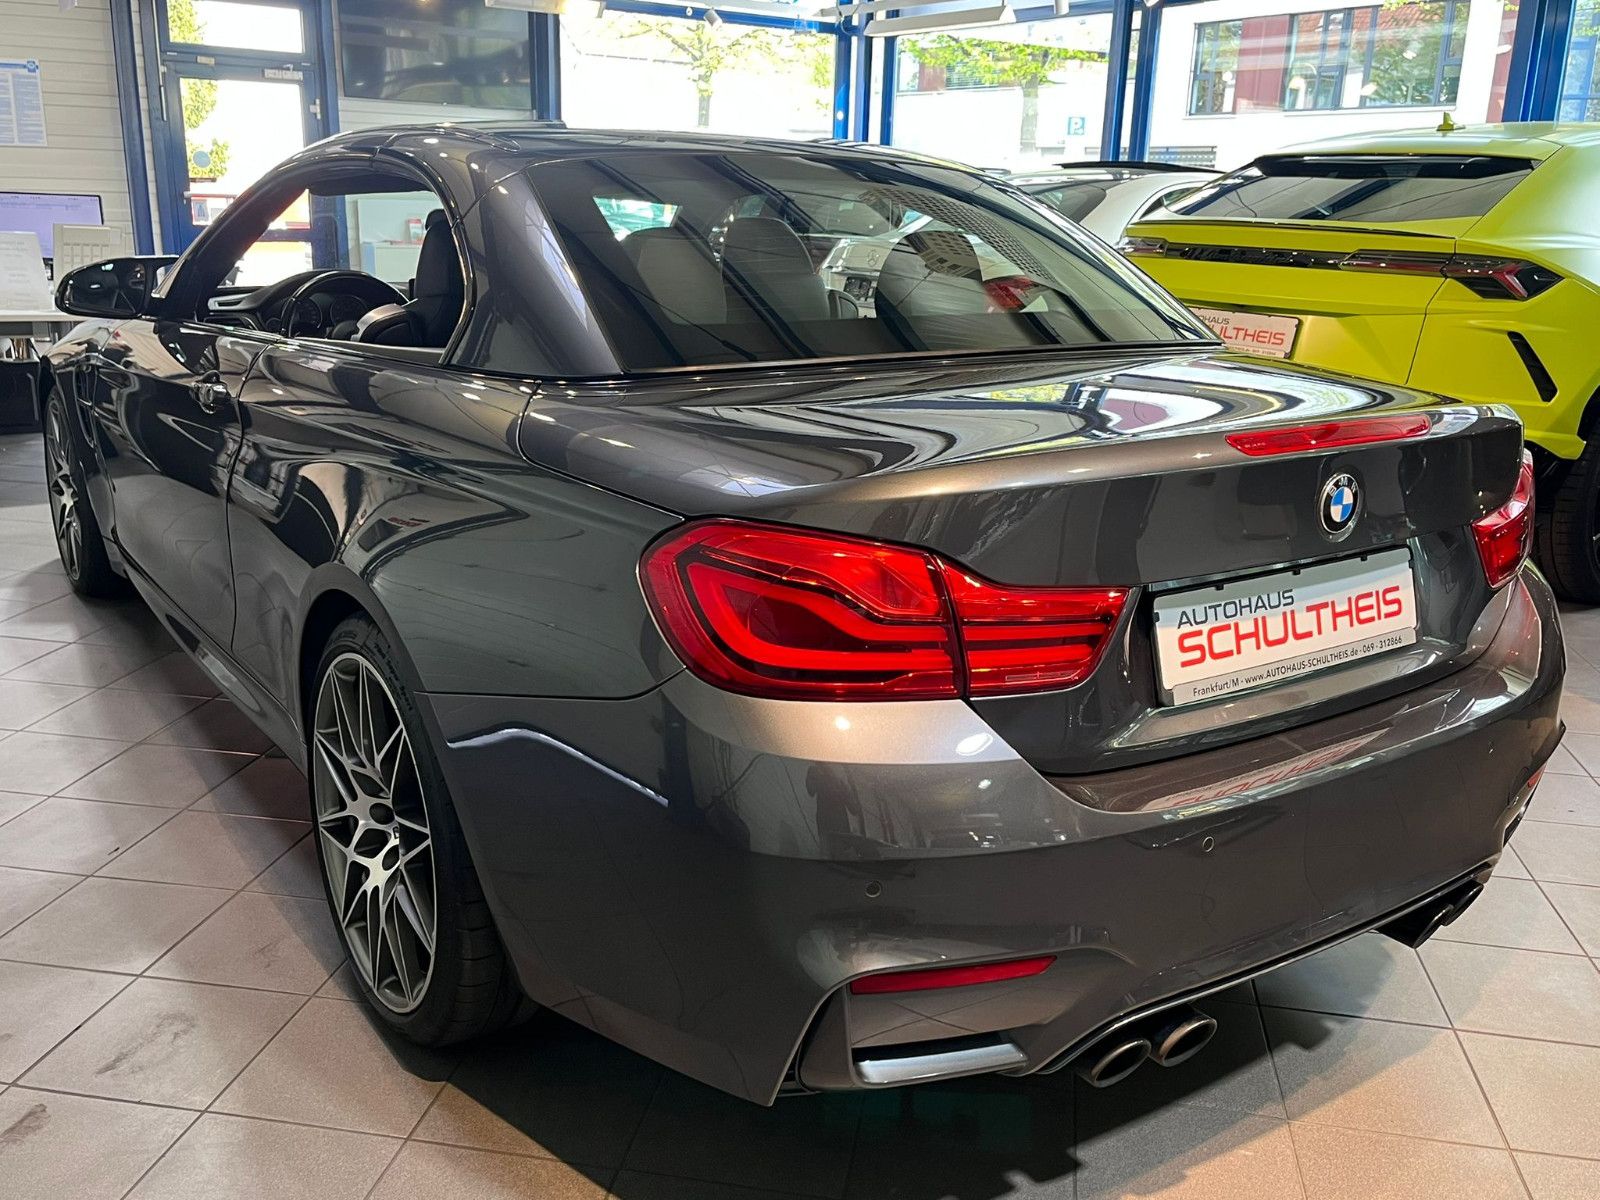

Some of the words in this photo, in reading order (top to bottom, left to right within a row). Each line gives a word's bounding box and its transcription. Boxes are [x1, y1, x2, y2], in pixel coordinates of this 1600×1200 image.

[1070, 117, 1083, 135] P
[1199, 315, 1230, 325] OHAUS
[1211, 324, 1286, 346] ULTHEIS
[1328, 476, 1358, 497] BMW
[1177, 588, 1295, 629] AUTOHAUS
[1178, 585, 1403, 668] SCHULTHEIS
[1193, 677, 1240, 697] Frankfurt/M
[1244, 647, 1359, 684] www.AUTOHAUS-SCHULTHEIS.de
[1362, 642, 1375, 654] 069
[1379, 637, 1403, 649] 312866
